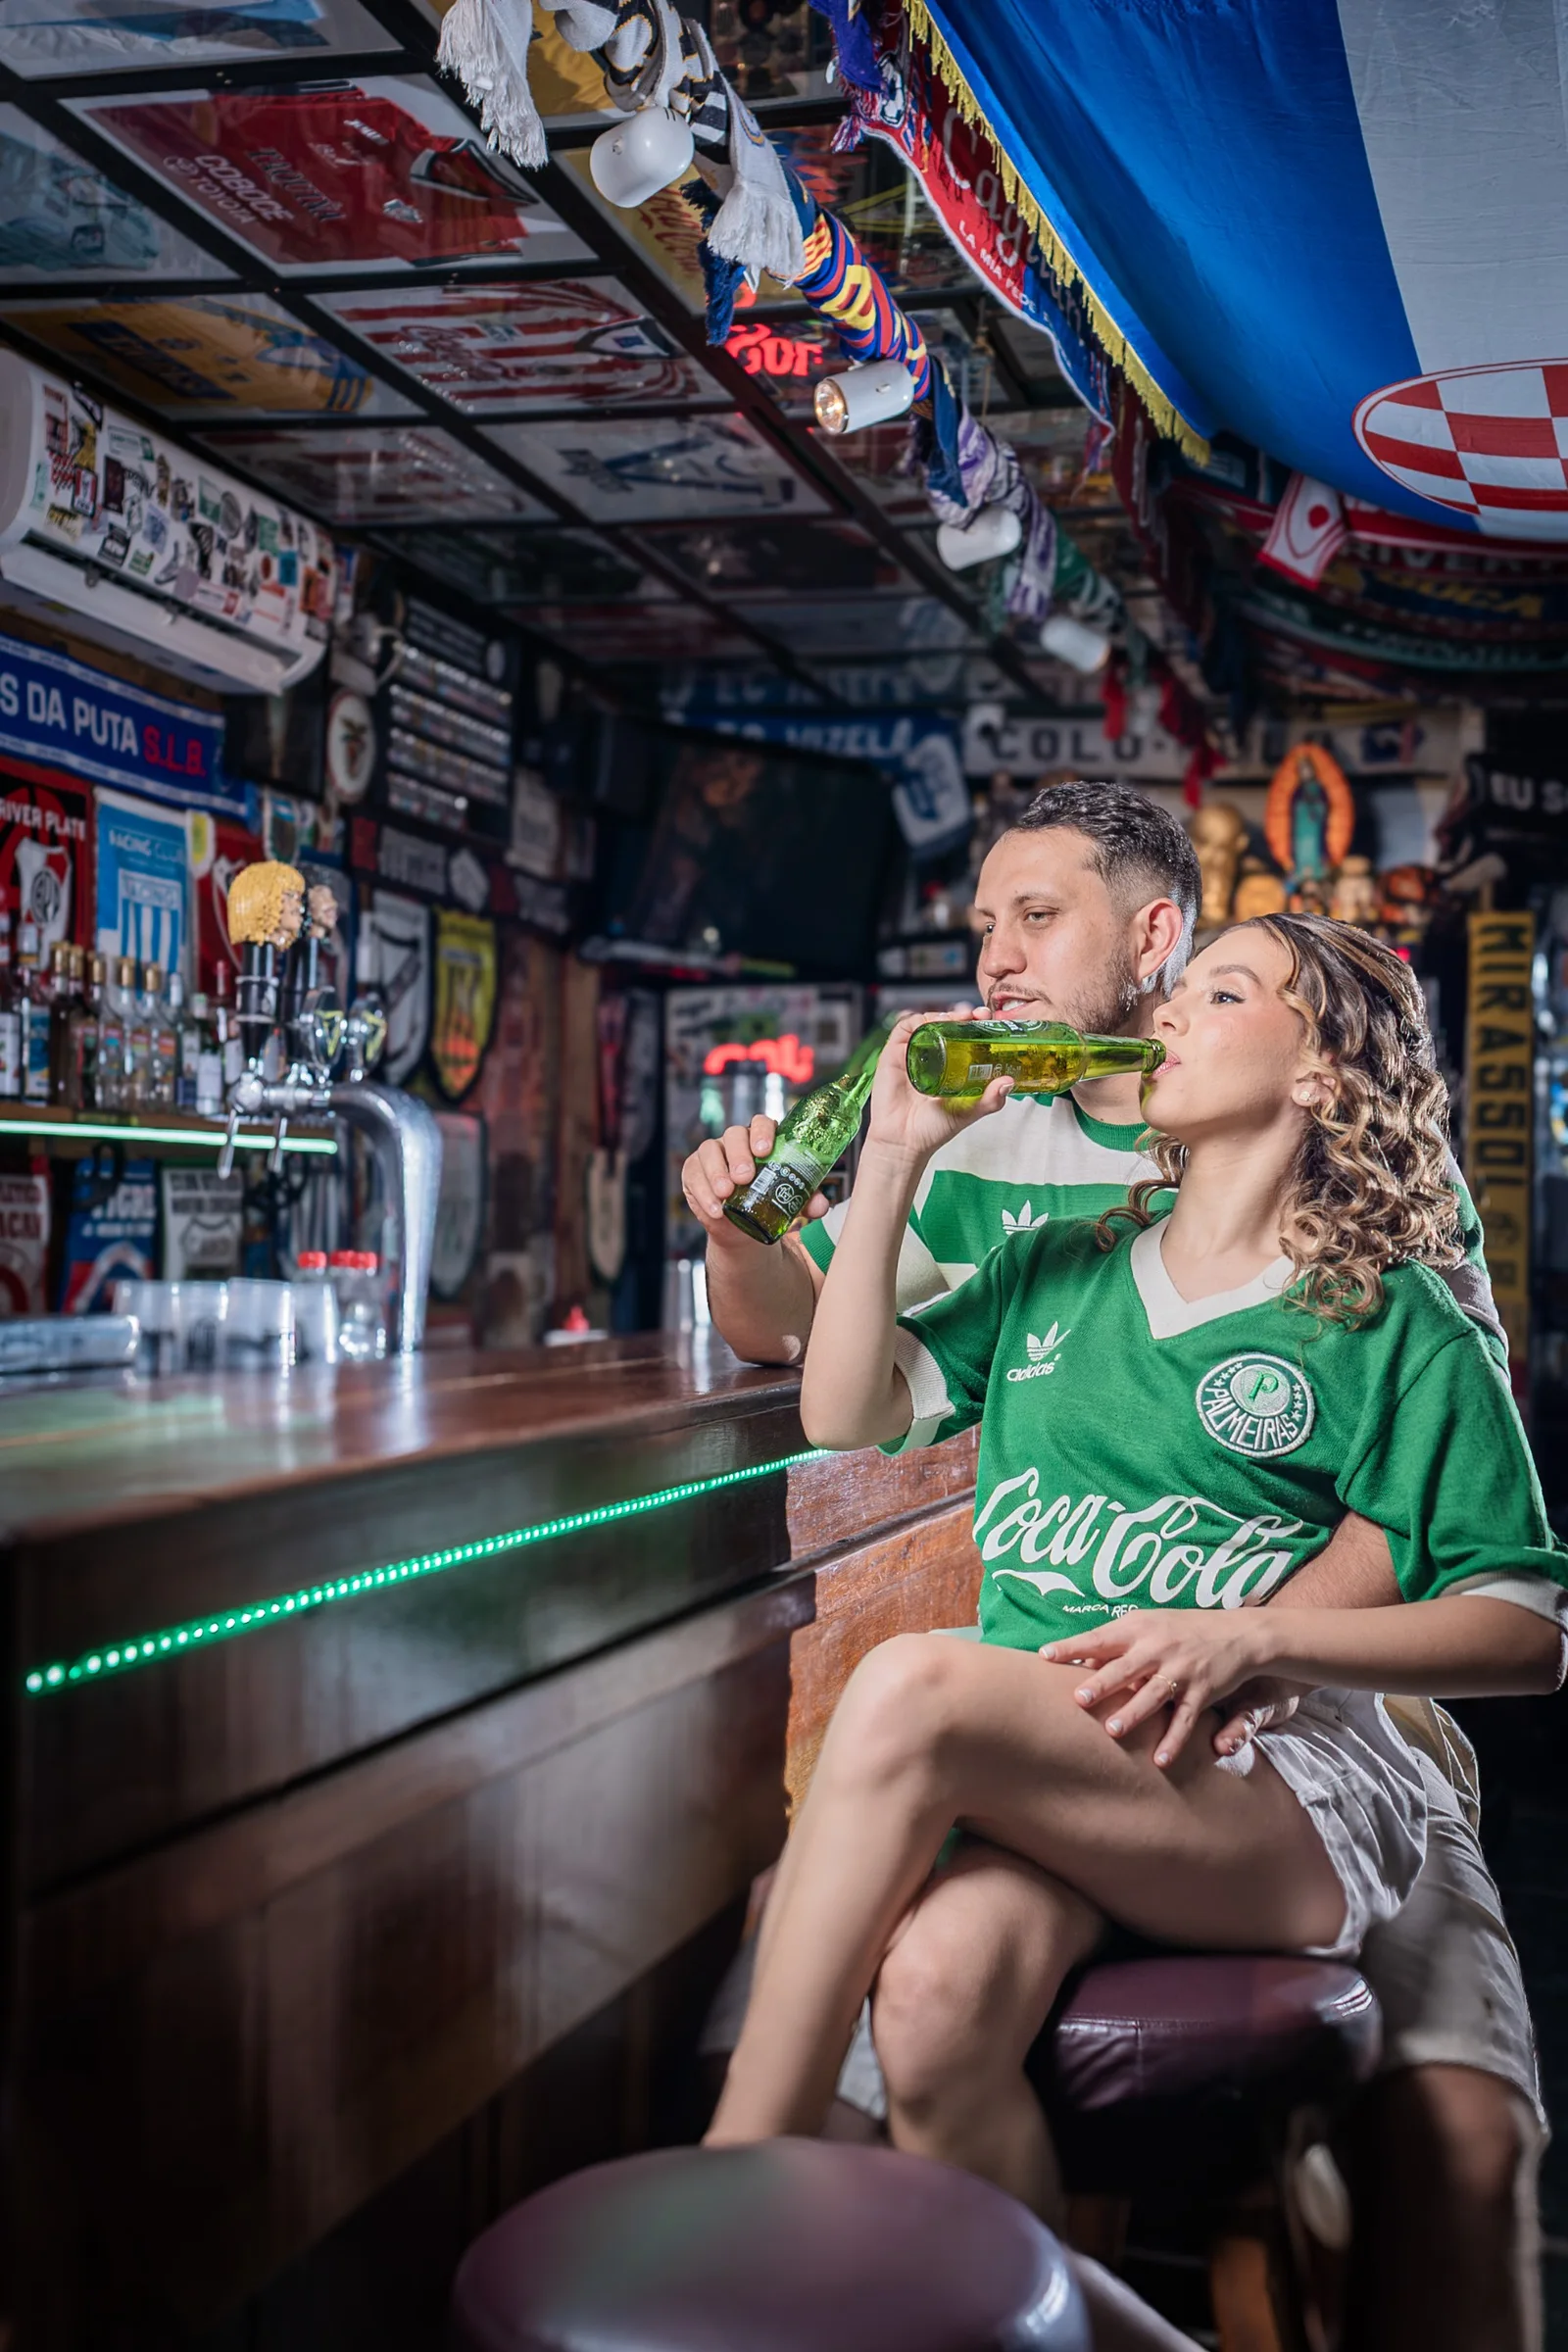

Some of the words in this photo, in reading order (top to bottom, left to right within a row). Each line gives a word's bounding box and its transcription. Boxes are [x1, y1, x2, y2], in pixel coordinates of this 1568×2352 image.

[958, 220, 977, 250] LA
[980, 248, 1004, 280] MIA
[27, 681, 68, 731] DA
[74, 697, 138, 758] PUTA
[1006, 1361, 1055, 1382] adidas
[1201, 1386, 1299, 1451] PALMEIRAS
[972, 1466, 1304, 1610] Coca-Cola
[1062, 1603, 1109, 1614] MARCA
